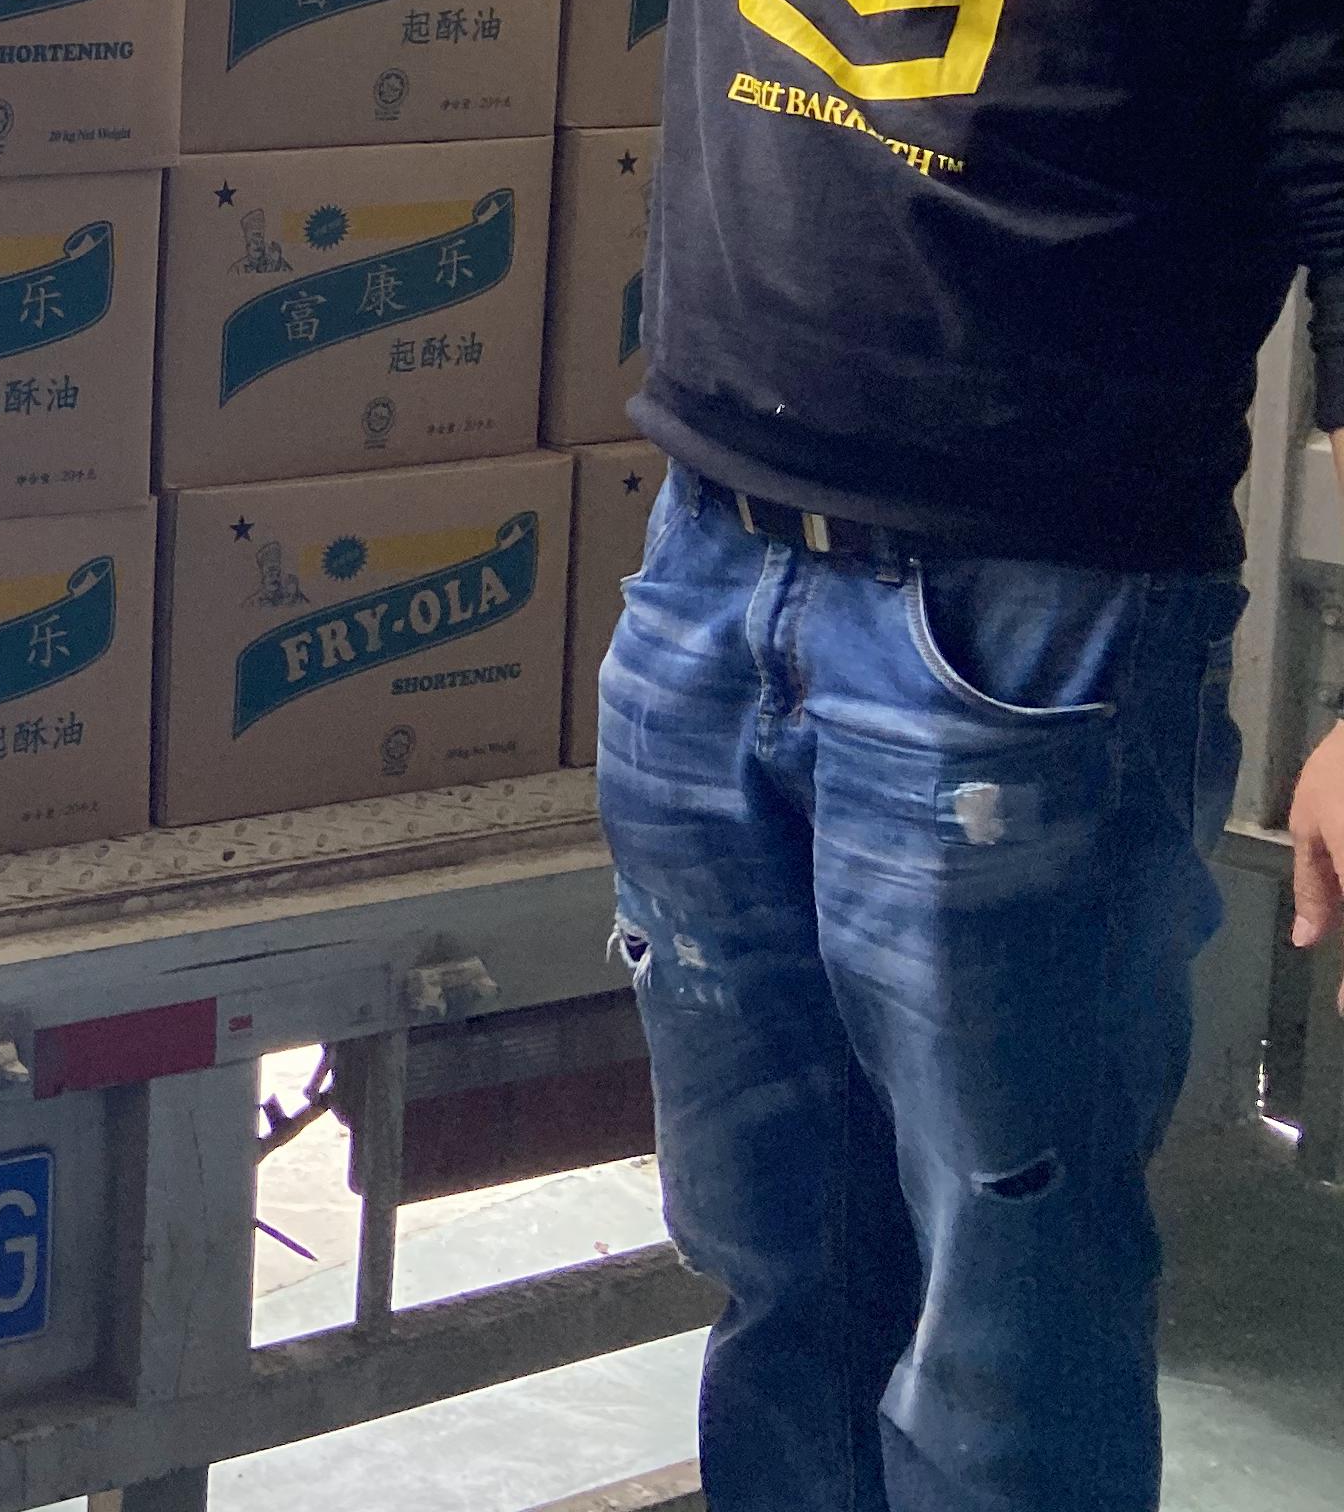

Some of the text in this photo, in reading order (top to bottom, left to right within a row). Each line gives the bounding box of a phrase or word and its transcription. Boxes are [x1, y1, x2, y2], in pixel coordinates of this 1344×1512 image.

[400, 7, 501, 47] 起酥油
[280, 238, 473, 342] 富康乐
[388, 332, 483, 374] 起酥油
[280, 566, 510, 684] FRY-OLA
[391, 662, 521, 696] SHORTENING
